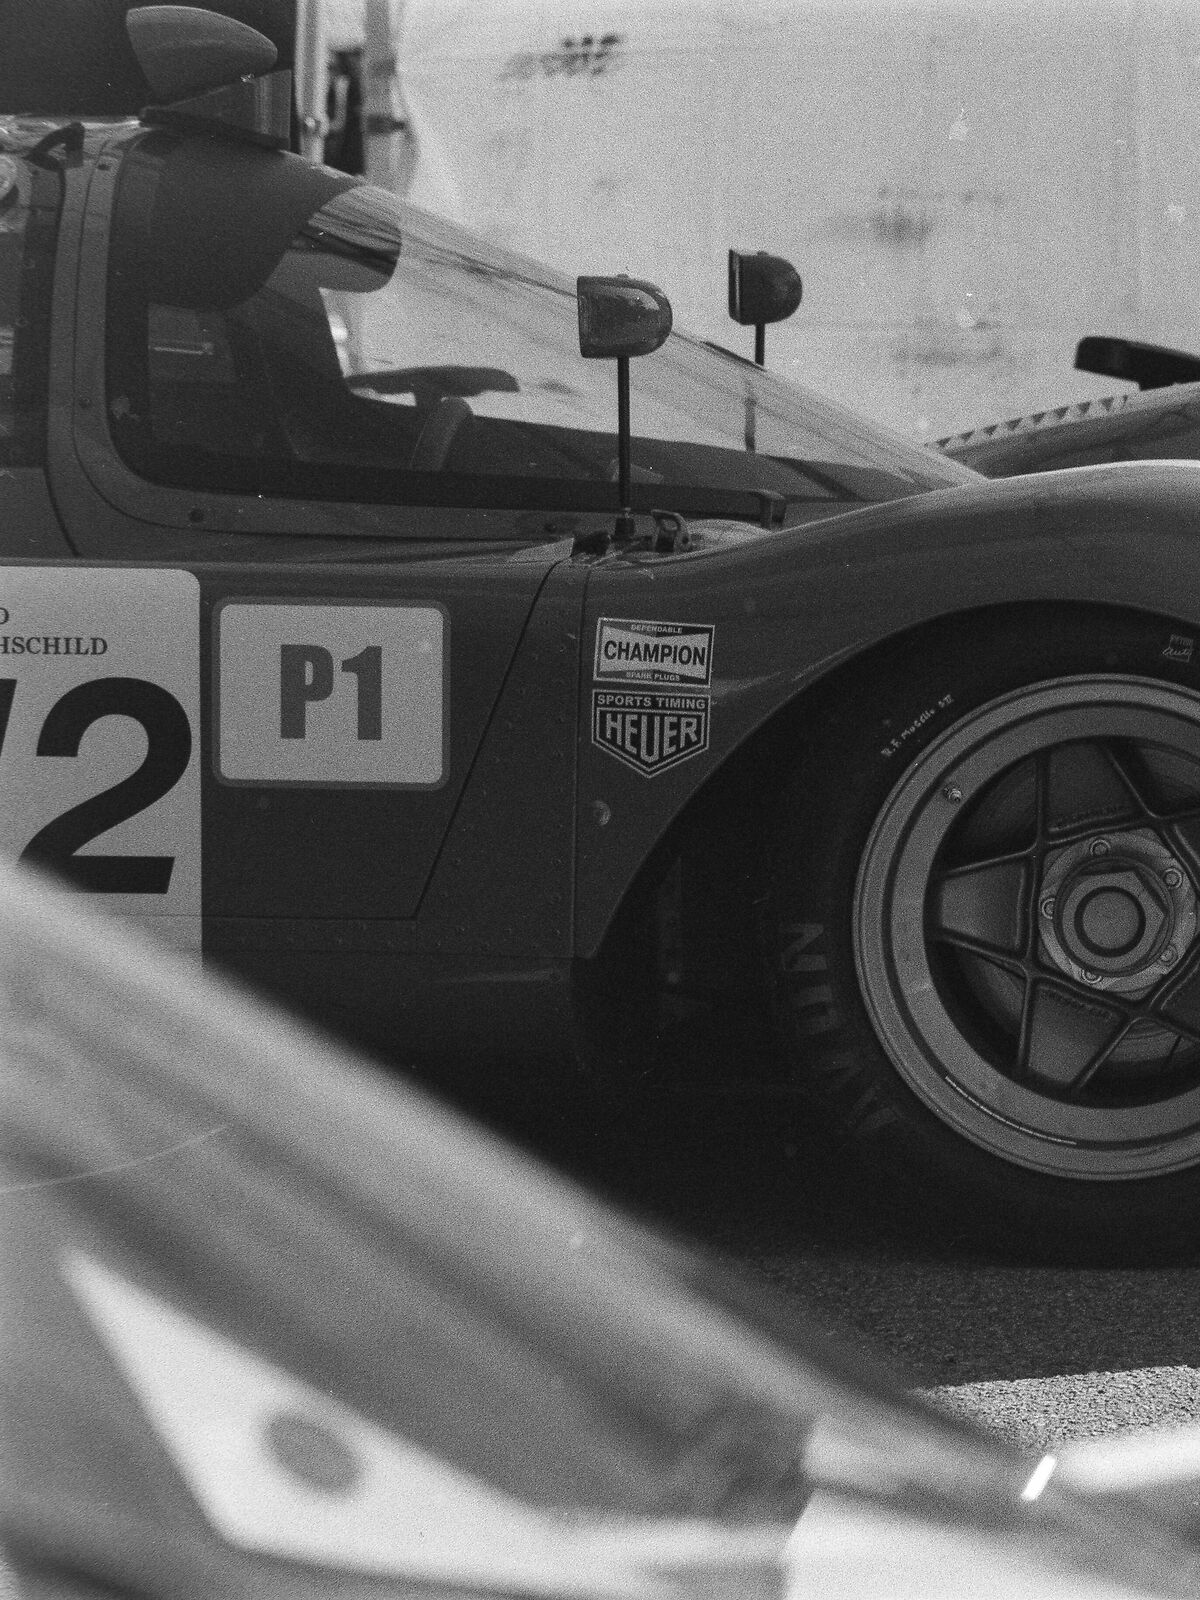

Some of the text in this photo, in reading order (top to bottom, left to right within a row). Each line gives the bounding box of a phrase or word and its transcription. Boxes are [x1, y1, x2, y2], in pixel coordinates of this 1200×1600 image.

[631, 624, 683, 634] DEPENDABLE
[604, 640, 706, 666] CHAMPION
[654, 673, 681, 682] PLUGS
[280, 644, 383, 741] P1
[598, 695, 706, 710] SPORTS TIMING
[606, 713, 698, 763] HEUER
